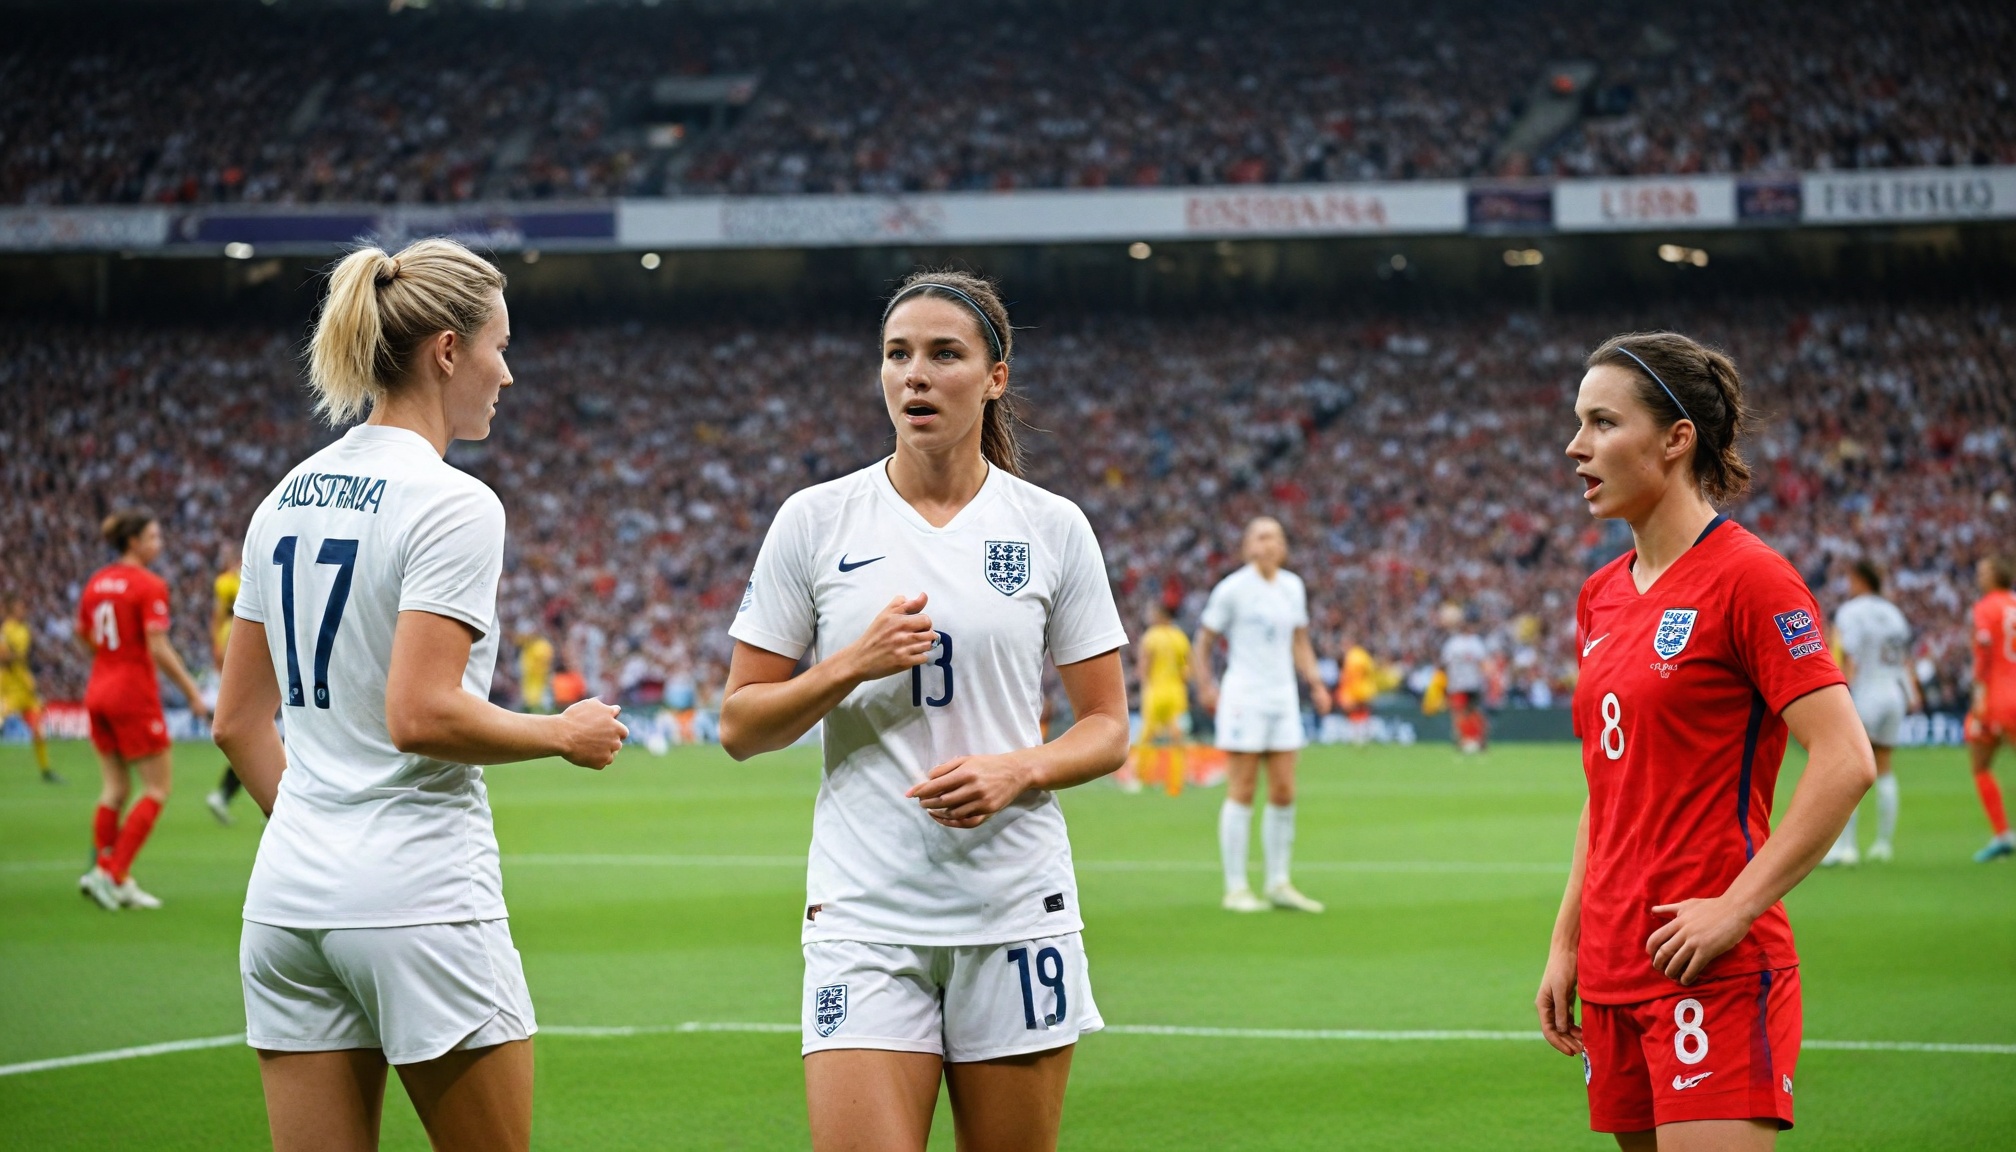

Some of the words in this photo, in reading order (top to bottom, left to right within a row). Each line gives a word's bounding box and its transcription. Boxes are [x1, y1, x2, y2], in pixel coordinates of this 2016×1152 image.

[273, 535, 359, 709] 17
[912, 630, 954, 707] 13
[1601, 692, 1625, 760] 8
[1674, 998, 1709, 1065] 8
